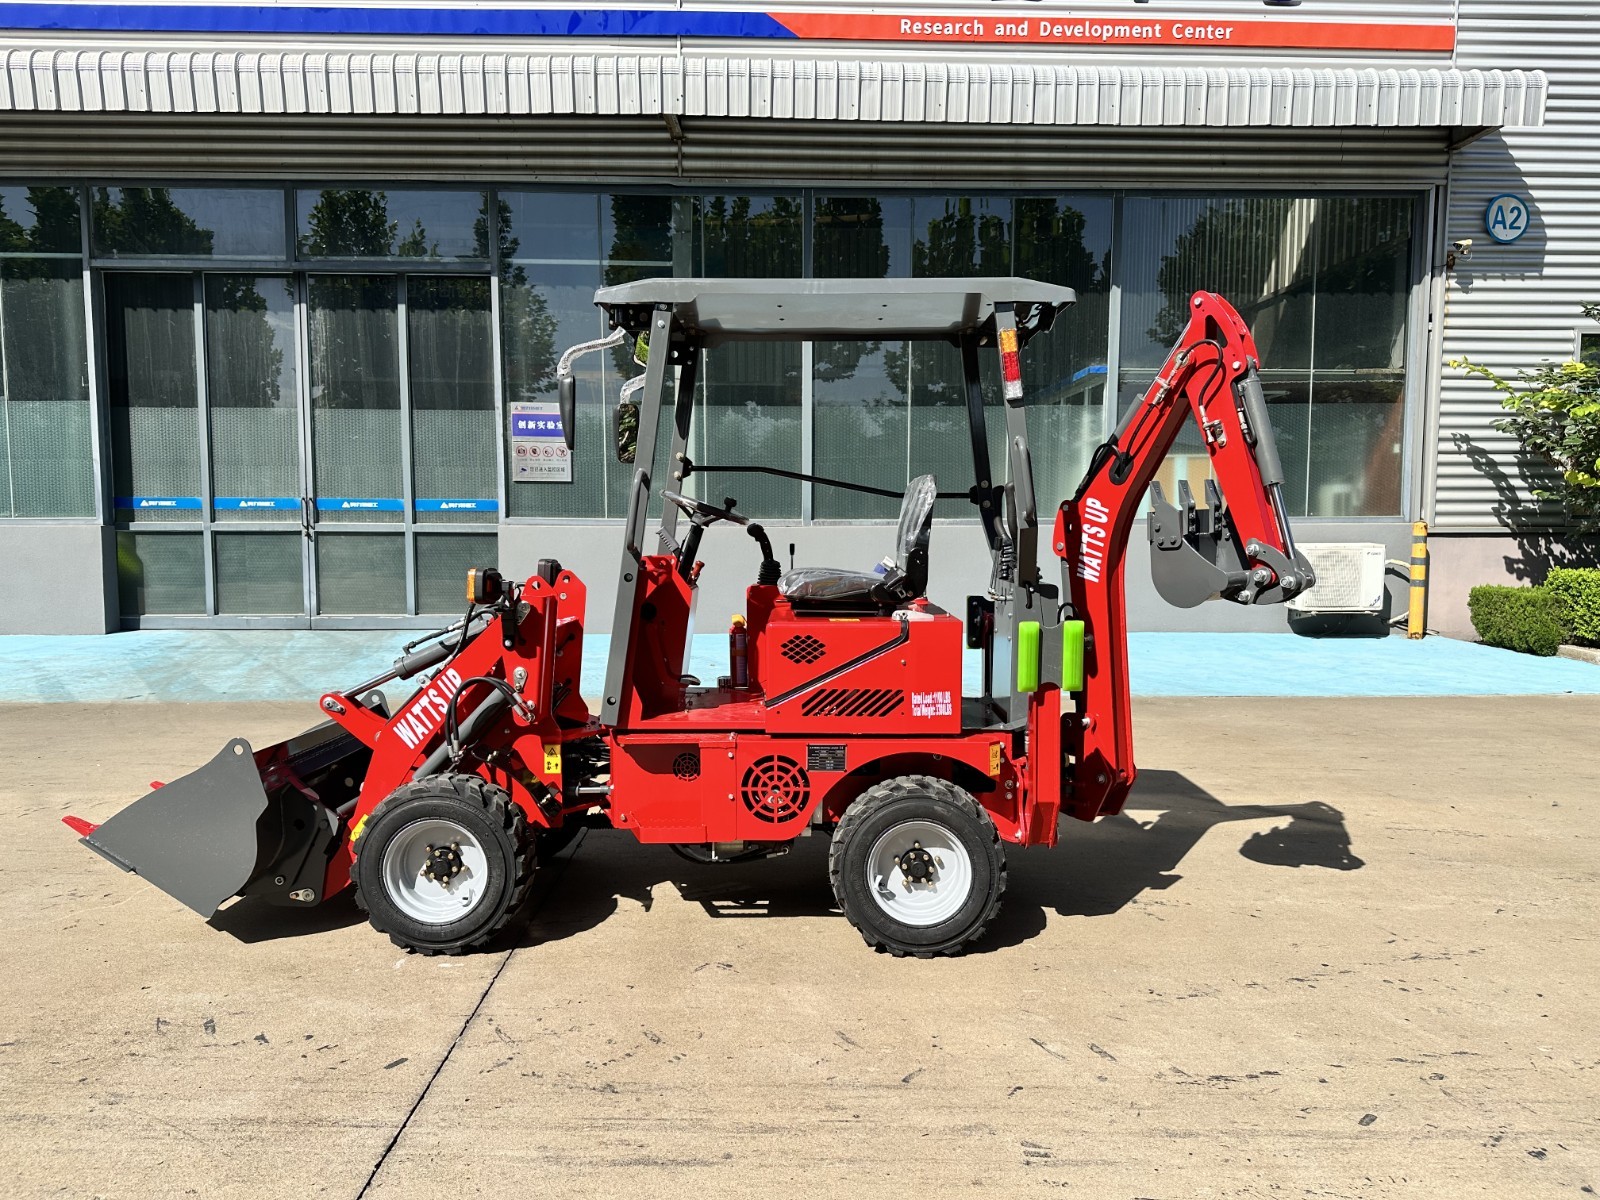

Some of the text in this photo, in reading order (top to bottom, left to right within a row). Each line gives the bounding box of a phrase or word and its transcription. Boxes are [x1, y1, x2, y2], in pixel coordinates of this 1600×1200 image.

[900, 18, 1234, 41] Research and Development Center
[1491, 205, 1522, 230] A2
[1076, 497, 1110, 583] WATTS UP
[392, 668, 466, 750] WATTS UP
